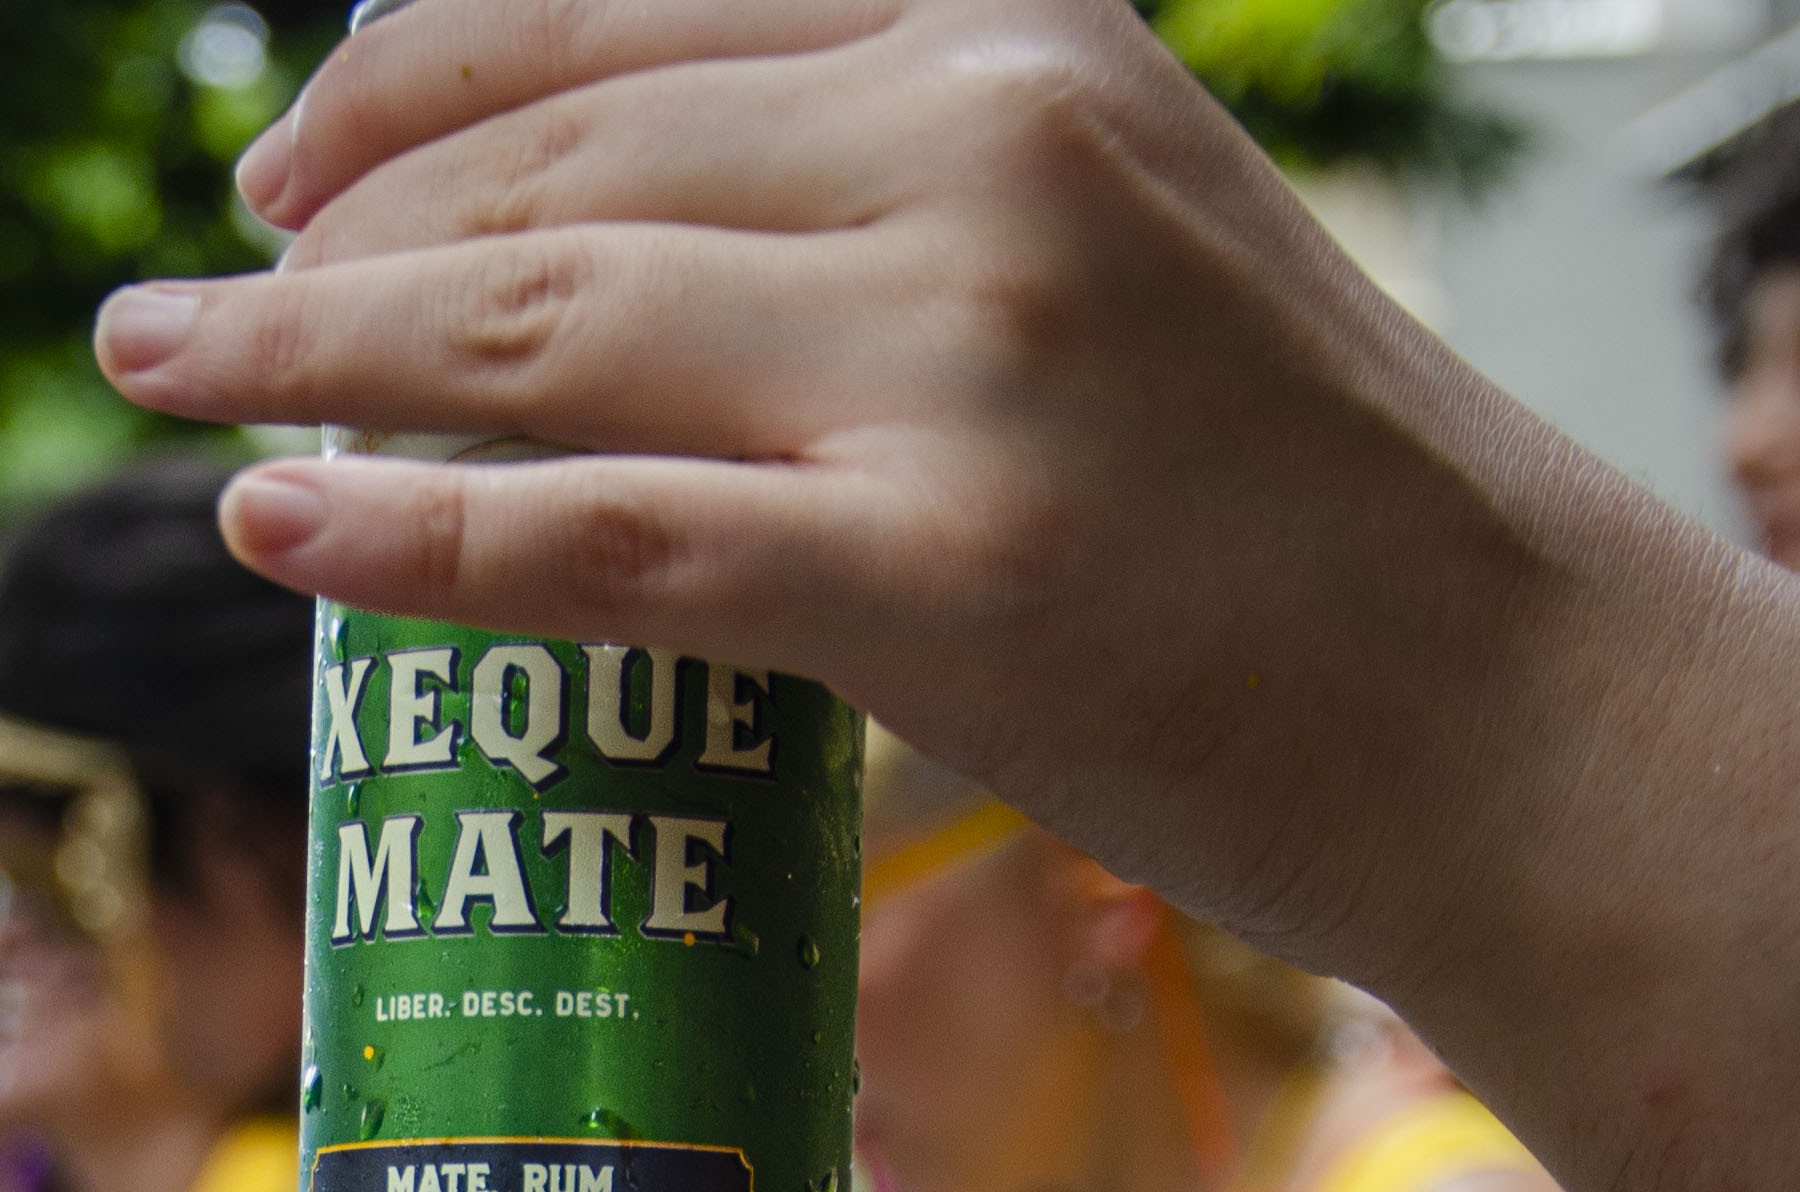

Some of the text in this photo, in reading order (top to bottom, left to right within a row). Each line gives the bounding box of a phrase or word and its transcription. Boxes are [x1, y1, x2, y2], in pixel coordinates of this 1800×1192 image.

[320, 642, 777, 793] XEQUE
[331, 811, 733, 946] MATE
[376, 991, 639, 1021] LIBER. DESC. DEST.
